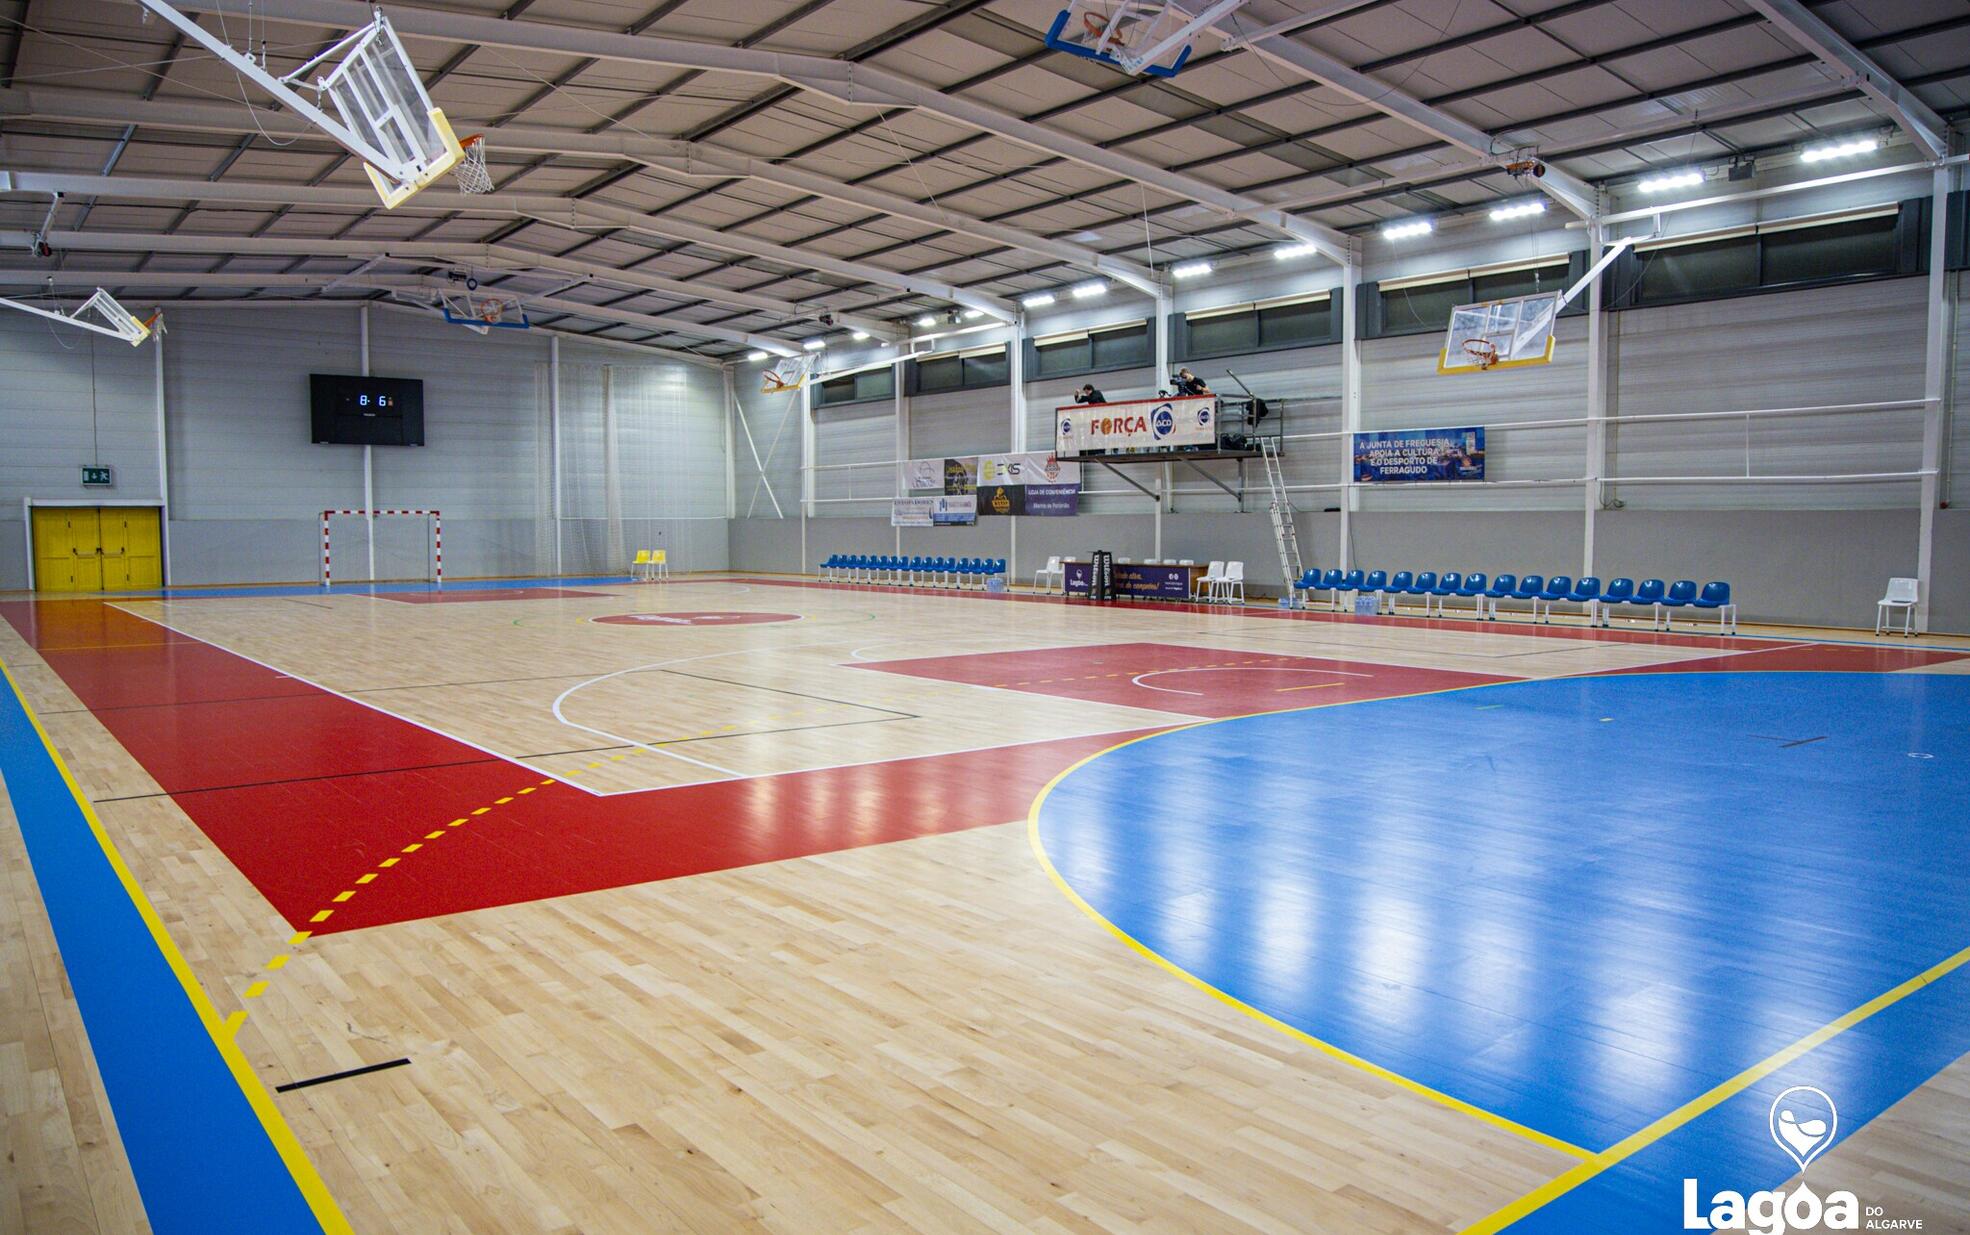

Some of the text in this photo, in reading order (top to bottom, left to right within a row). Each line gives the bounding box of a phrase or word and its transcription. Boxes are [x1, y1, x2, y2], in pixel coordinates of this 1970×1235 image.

[1091, 416, 1147, 437] FORÇA
[1360, 438, 1450, 449] A JUNTA DE FREGUESIA
[1369, 447, 1441, 458] APOIA A CULTURA
[1383, 457, 1425, 466] DESPORTO
[1427, 457, 1438, 465] DE
[1380, 466, 1428, 475] FERRAGUDO
